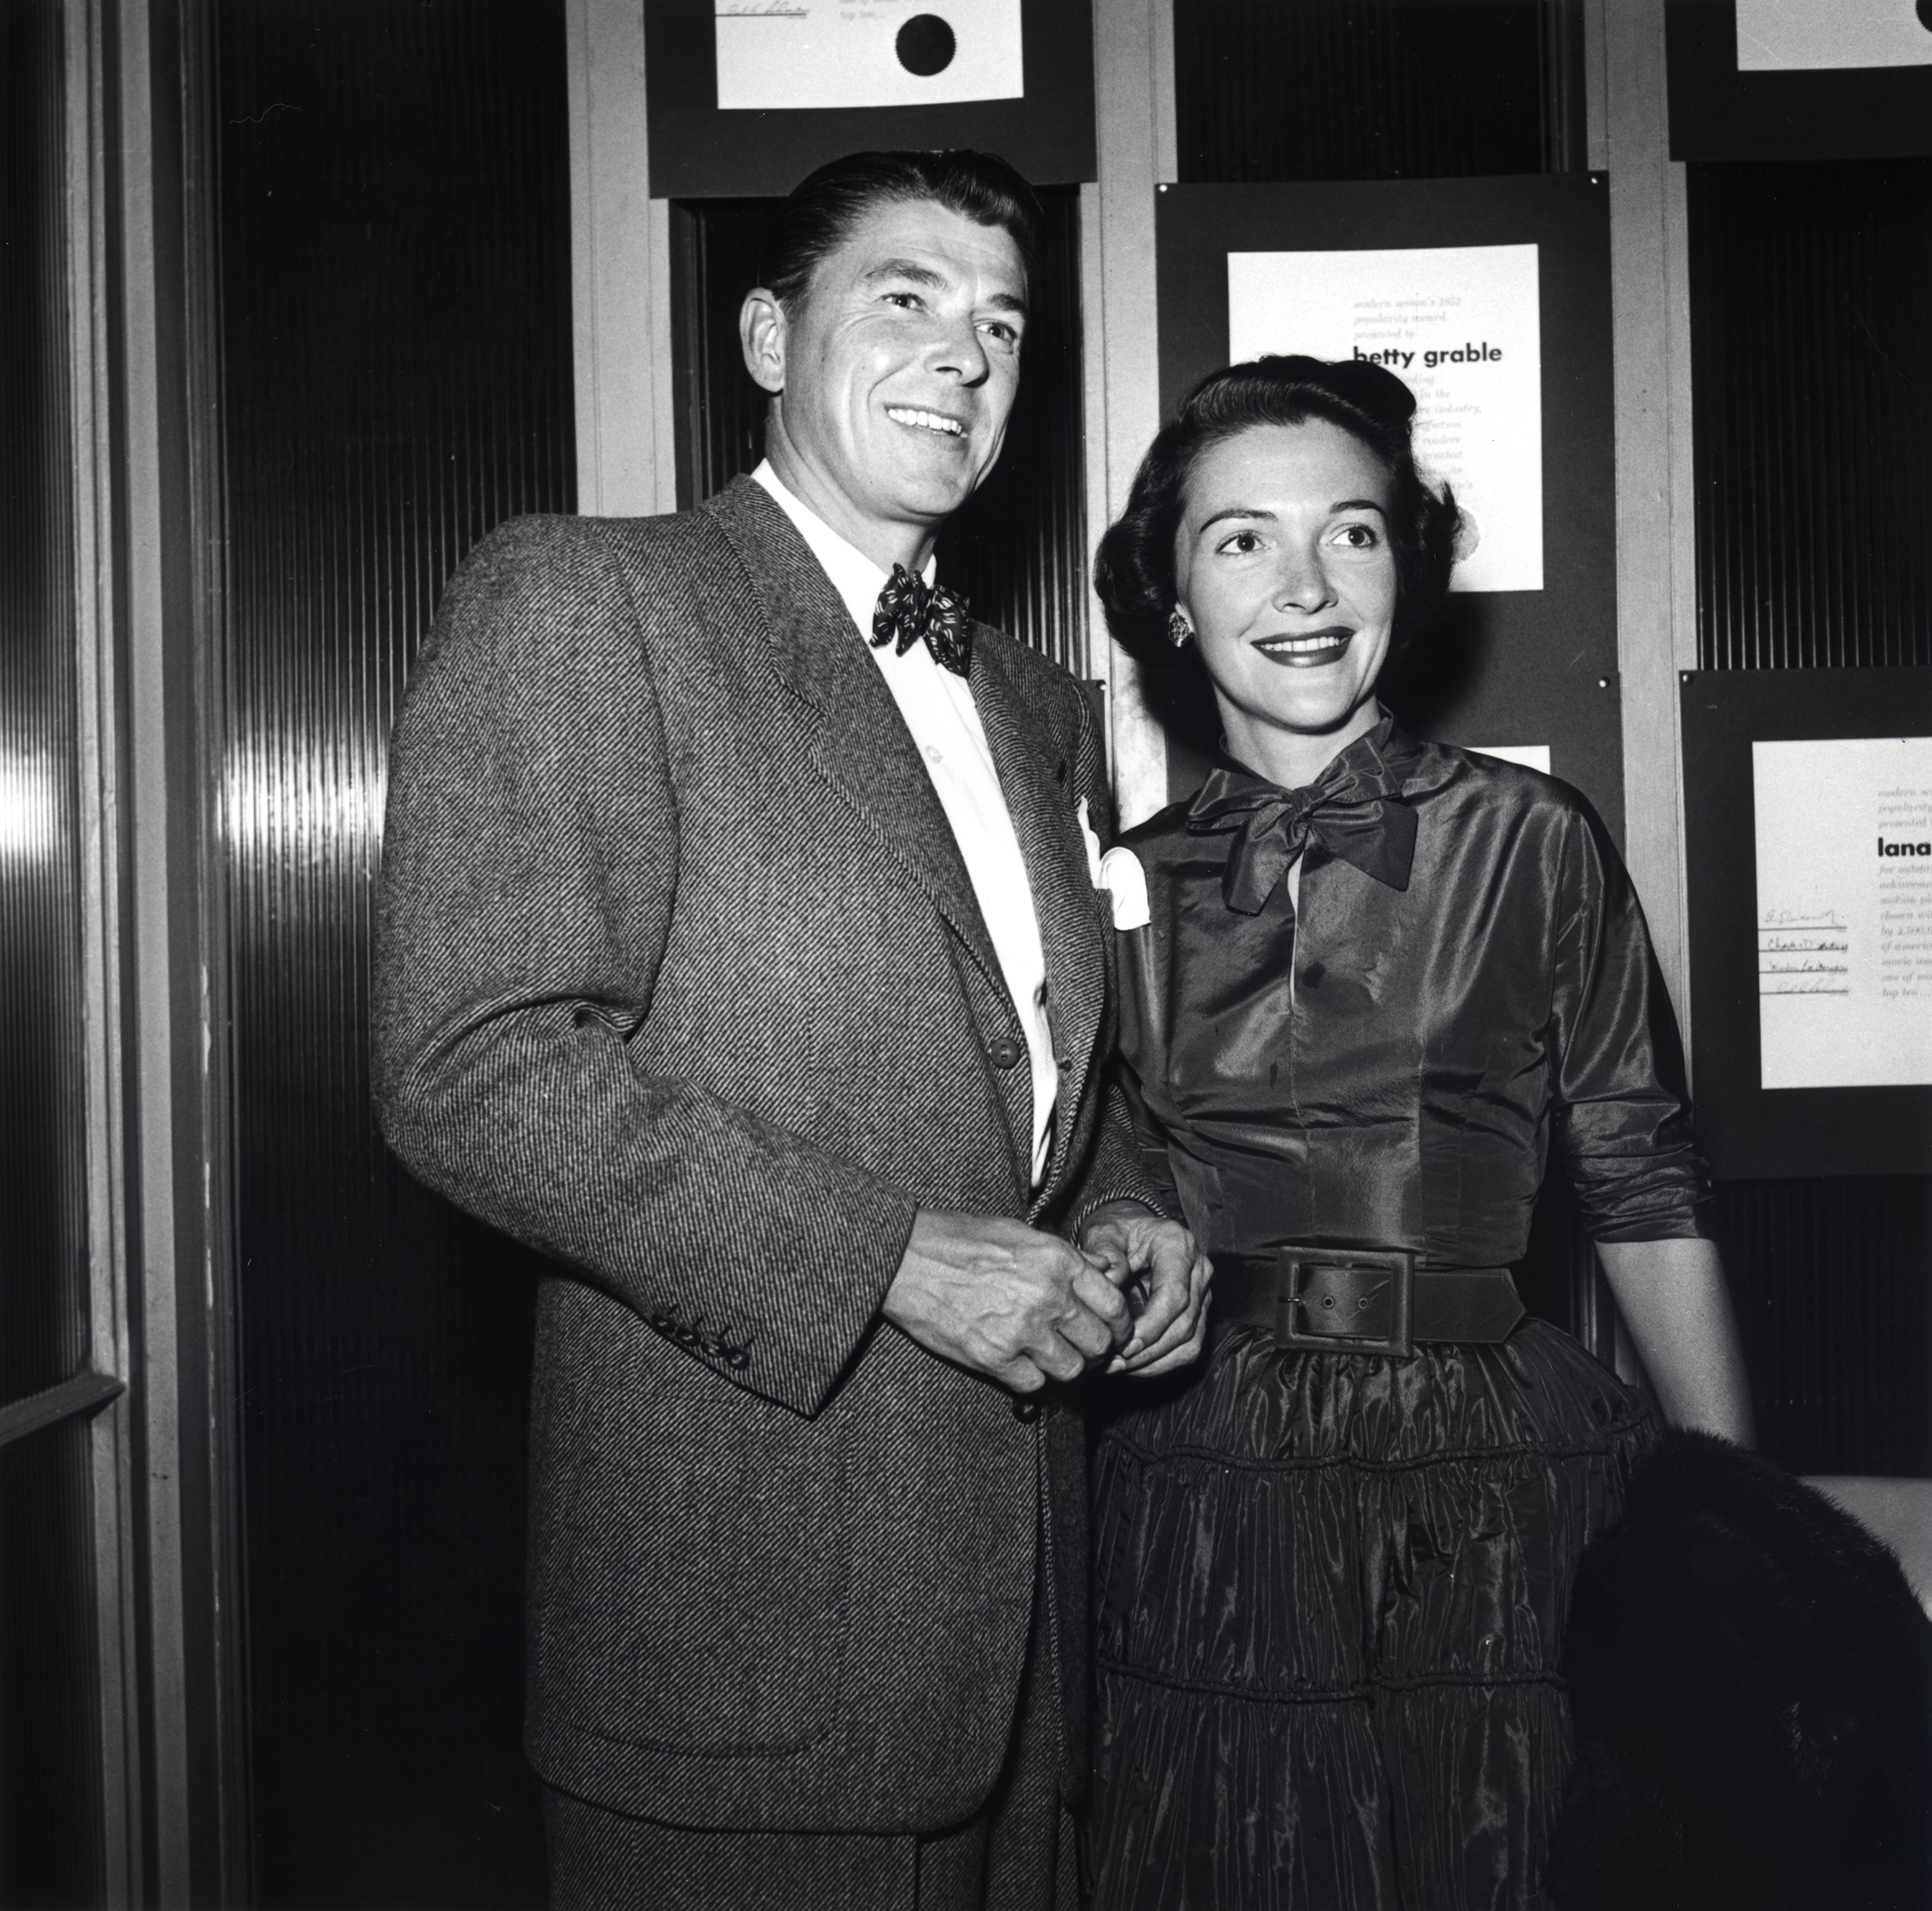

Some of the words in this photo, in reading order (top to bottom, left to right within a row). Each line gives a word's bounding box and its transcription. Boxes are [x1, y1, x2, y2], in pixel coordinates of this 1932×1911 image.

[1353, 345, 1415, 368] betty
[1424, 342, 1502, 367] grable
[1877, 837, 1932, 857] lana
